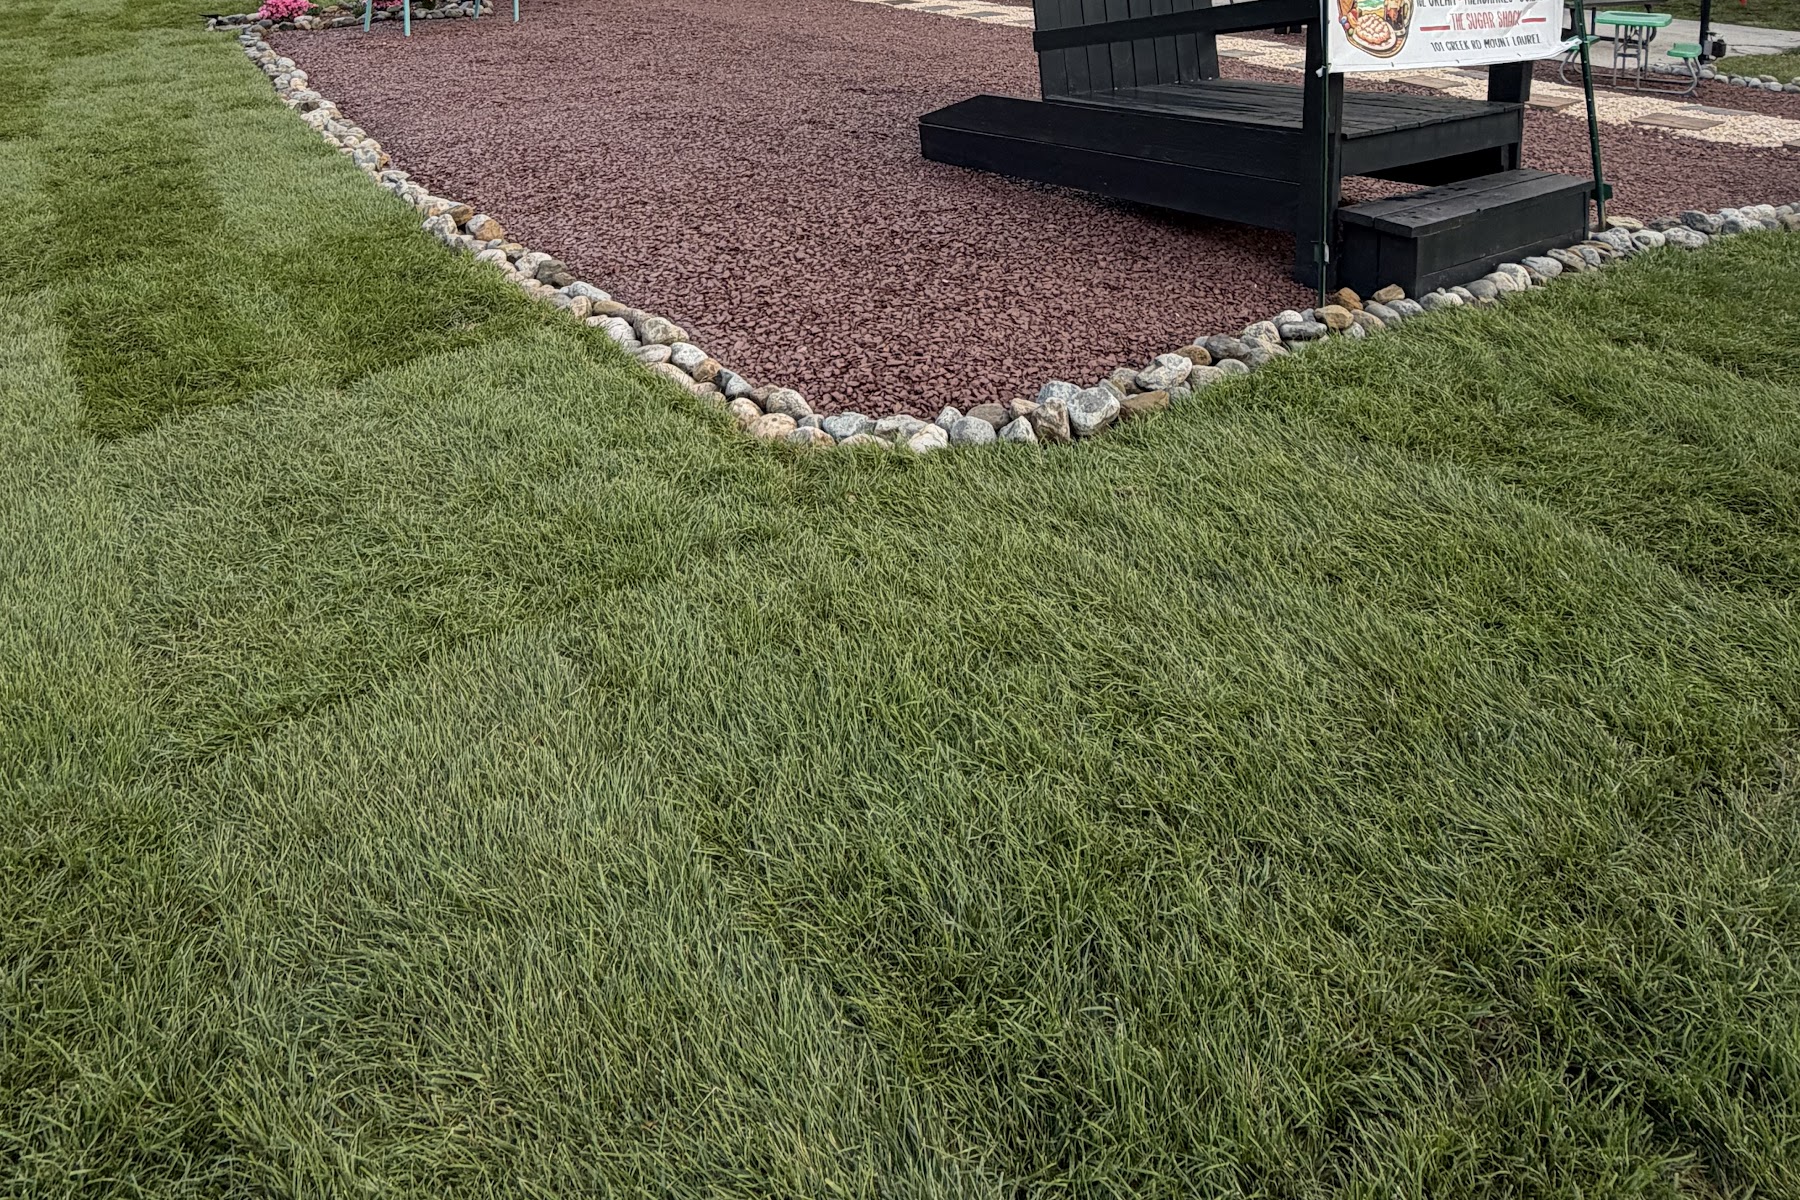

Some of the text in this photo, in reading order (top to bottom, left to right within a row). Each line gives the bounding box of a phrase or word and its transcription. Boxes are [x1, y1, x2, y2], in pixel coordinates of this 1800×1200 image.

[1450, 9, 1523, 31] THE SUGAR SHACK
[1430, 33, 1542, 52] 101 CREEK RD MOUNT LAUREL
